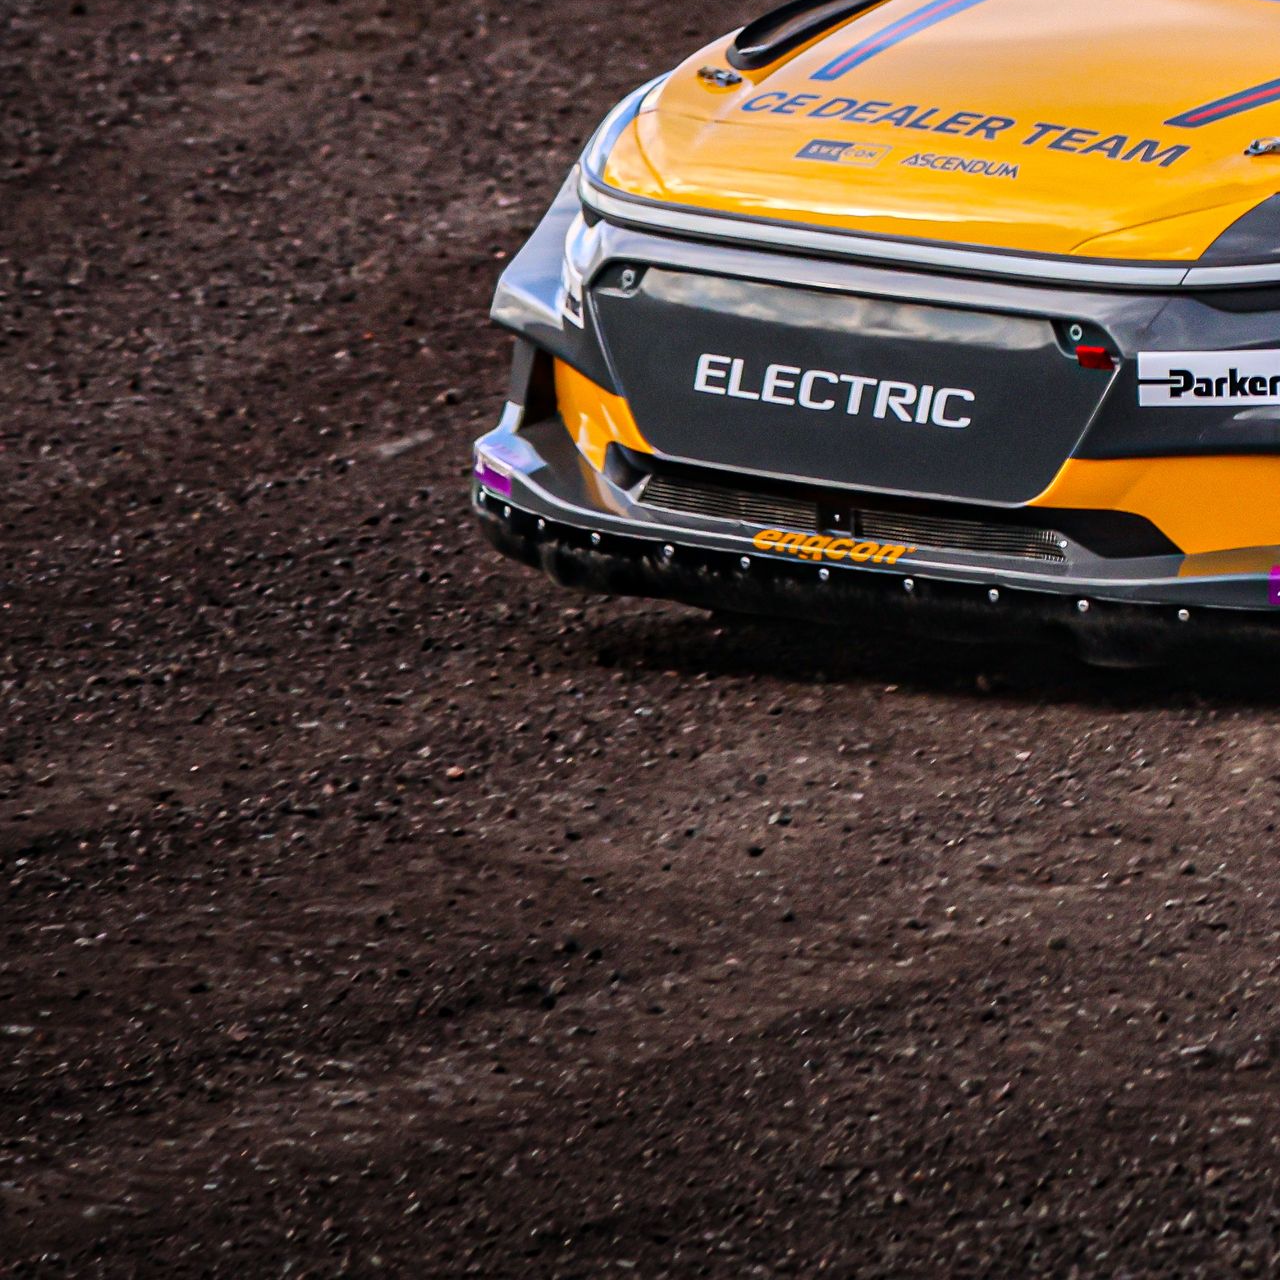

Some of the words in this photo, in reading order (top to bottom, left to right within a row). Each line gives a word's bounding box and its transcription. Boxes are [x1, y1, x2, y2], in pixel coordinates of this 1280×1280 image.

[742, 92, 823, 116] CE
[808, 97, 1016, 140] DEALER
[1021, 122, 1191, 168] TEAM
[900, 153, 1020, 179] ASCENDUM
[694, 353, 976, 428] ELECTRIC
[752, 529, 908, 565] engcon
